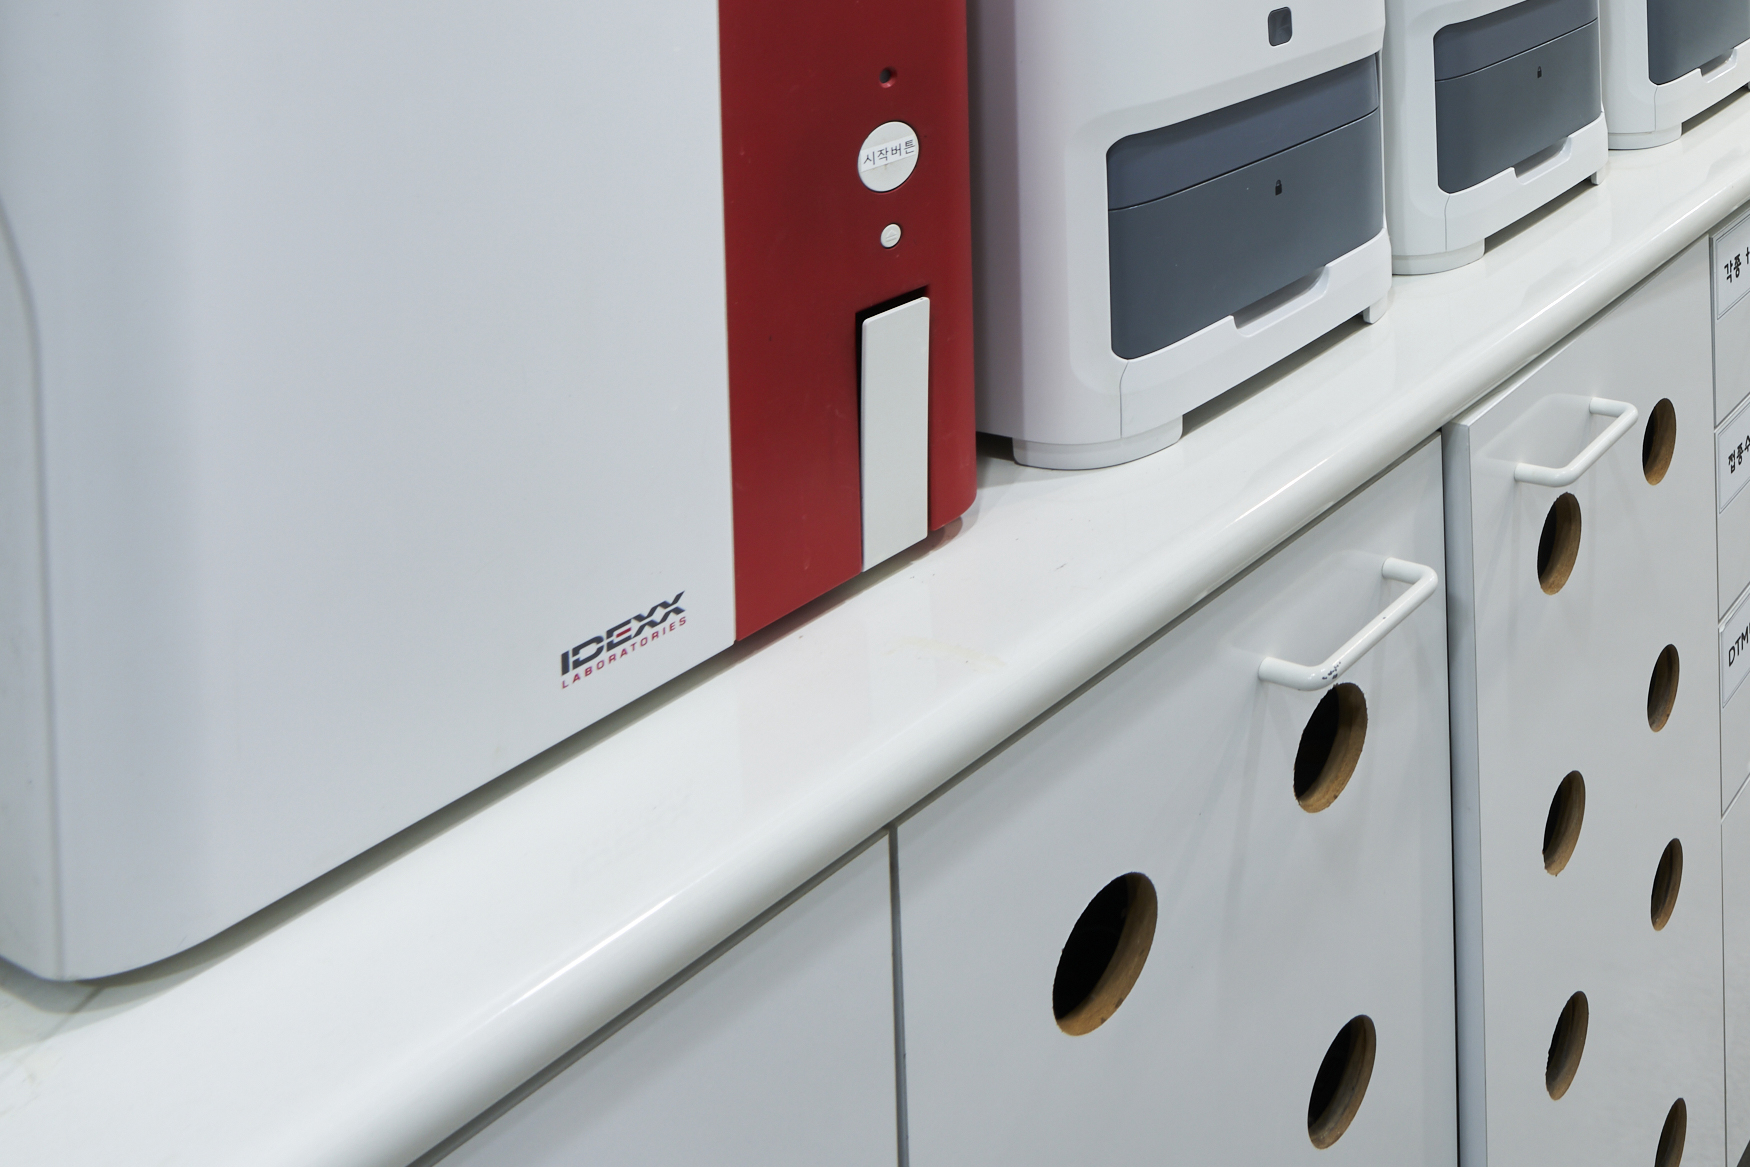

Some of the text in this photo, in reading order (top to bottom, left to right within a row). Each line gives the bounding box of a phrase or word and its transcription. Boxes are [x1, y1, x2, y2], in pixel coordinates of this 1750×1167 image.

[862, 140, 916, 168] 시작버튼
[1723, 254, 1743, 284] 각종
[560, 590, 686, 676] IDEXX
[560, 616, 688, 690] LABORATORIES
